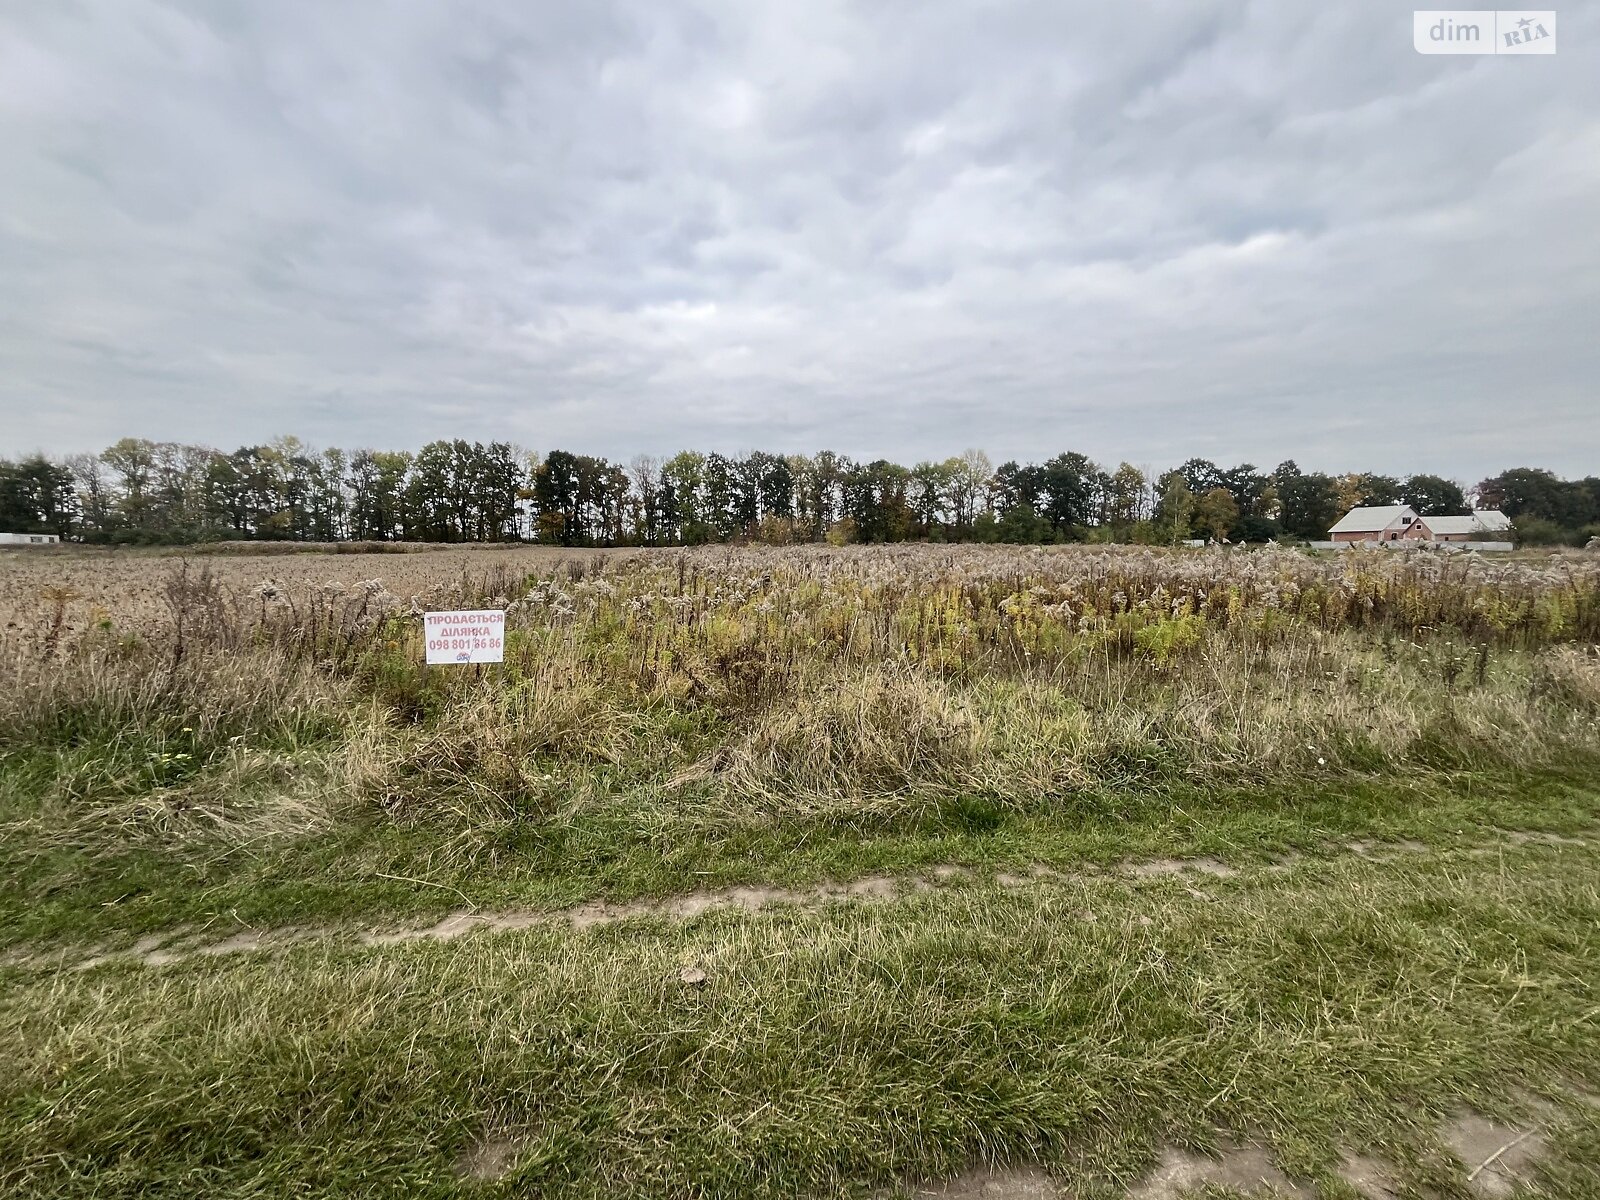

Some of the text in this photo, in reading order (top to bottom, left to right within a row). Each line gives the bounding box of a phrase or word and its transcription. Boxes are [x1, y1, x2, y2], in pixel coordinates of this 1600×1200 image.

[428, 614, 503, 625] ПРОДАЄТЬСЯ
[440, 627, 491, 637] ДІЛЯНКА
[429, 639, 449, 650] 098
[452, 638, 470, 650] 801
[489, 637, 501, 649] 86
